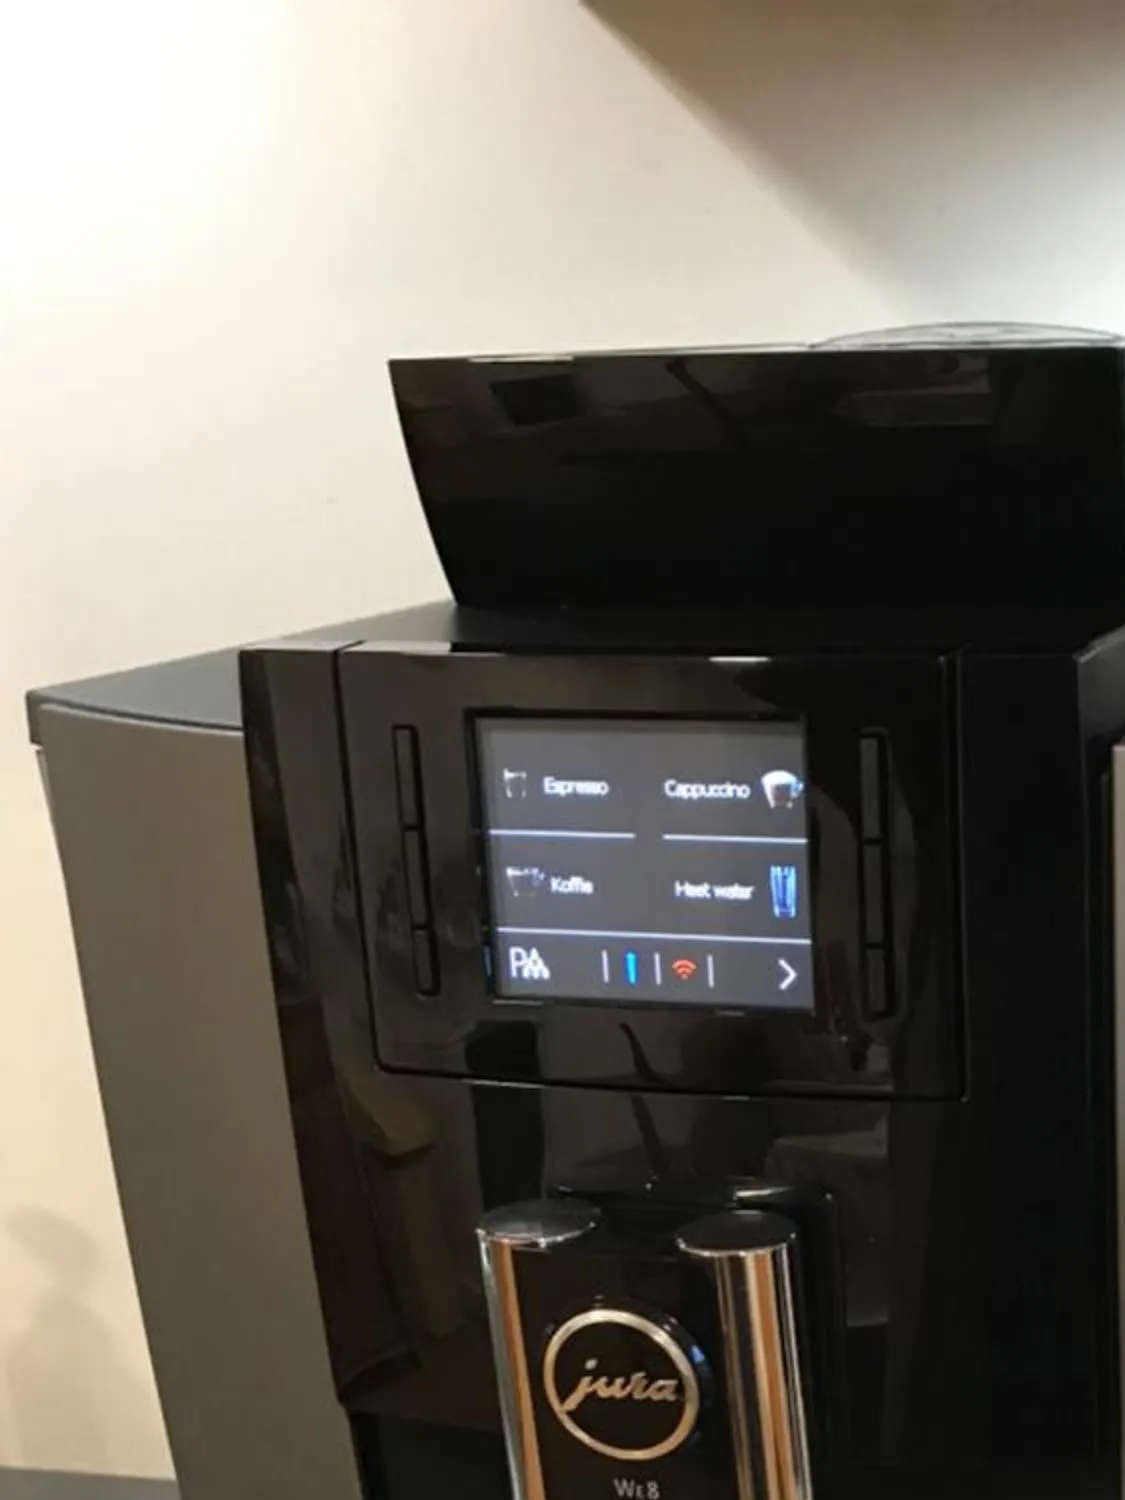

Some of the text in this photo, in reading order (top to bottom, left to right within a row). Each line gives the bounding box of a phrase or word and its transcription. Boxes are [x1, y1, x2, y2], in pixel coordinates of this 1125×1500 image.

[542, 776, 609, 797] Espresso
[663, 778, 751, 799] Cappuccino
[713, 882, 755, 900] water
[561, 1358, 680, 1414] jura
